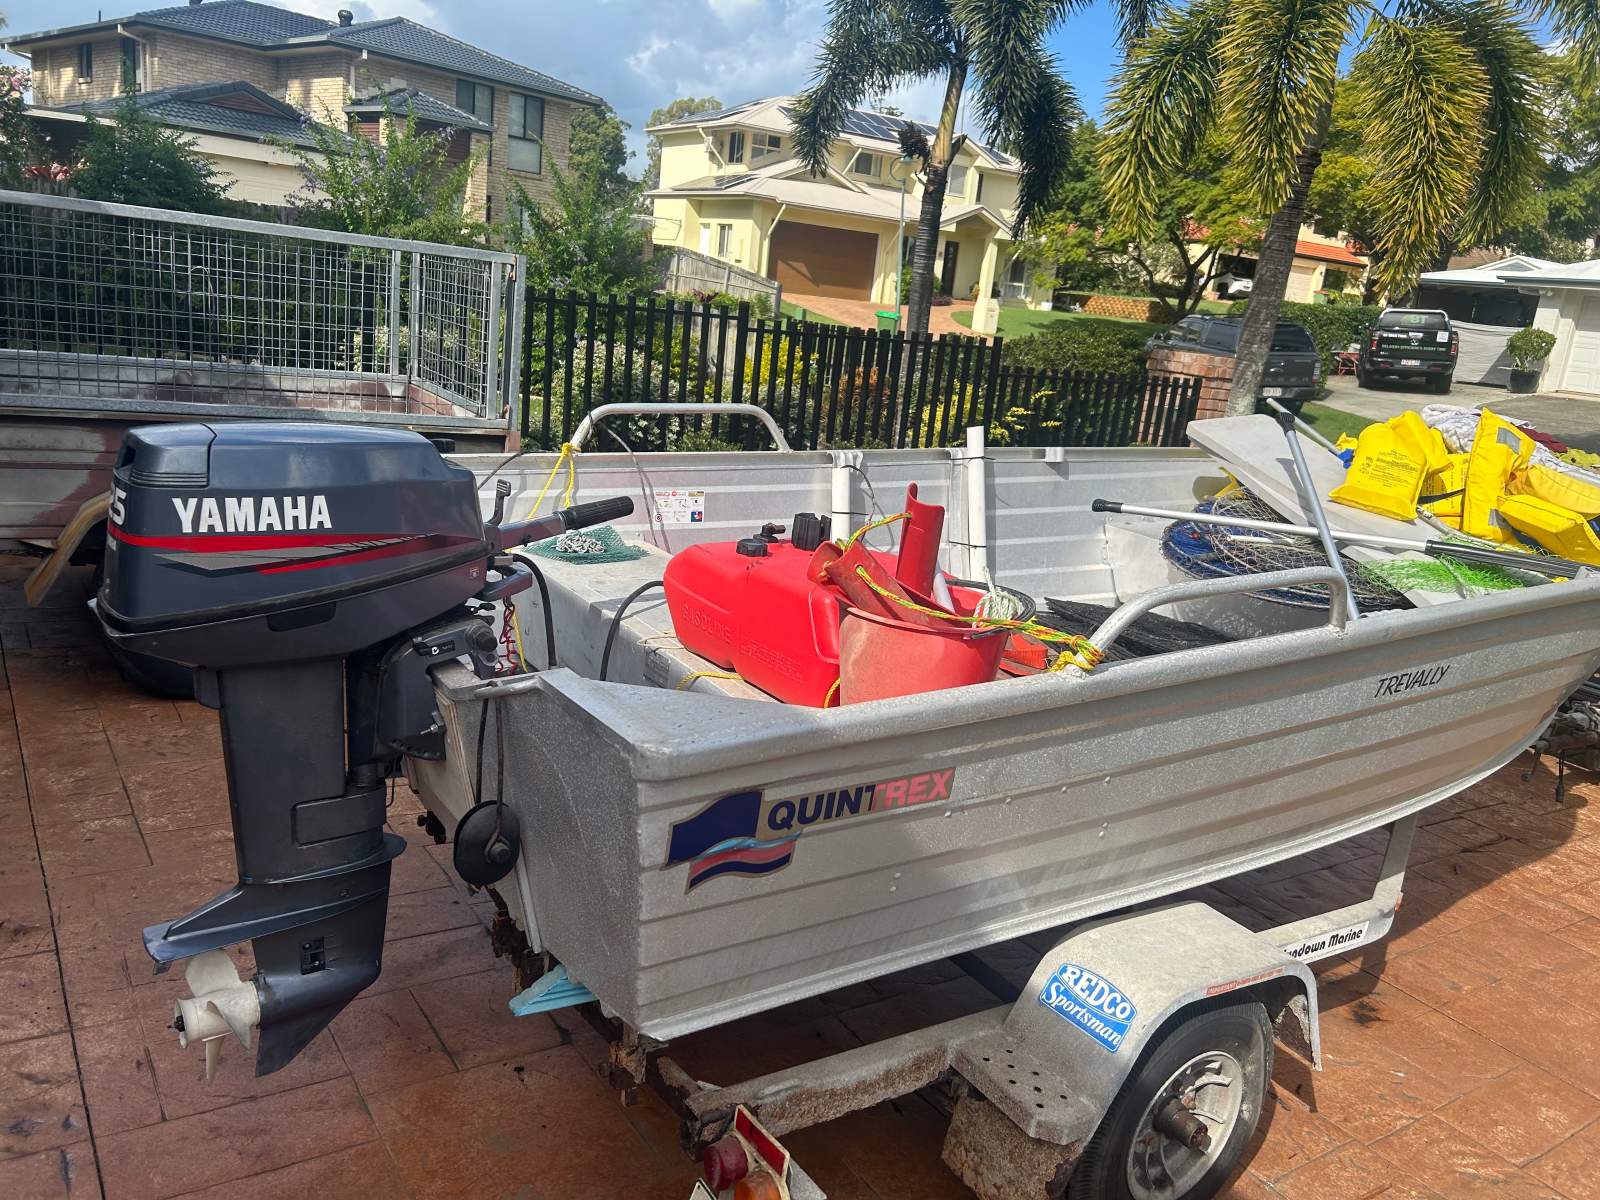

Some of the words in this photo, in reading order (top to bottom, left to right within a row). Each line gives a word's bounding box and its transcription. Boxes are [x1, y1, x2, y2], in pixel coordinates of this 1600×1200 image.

[172, 495, 332, 533] YAMAHA
[1374, 665, 1450, 698] TREVALLY
[768, 768, 956, 831] QUINTREX
[1328, 929, 1363, 948] Marine
[1041, 982, 1122, 1045] Sportsman
[1061, 966, 1131, 1019] REDCO
